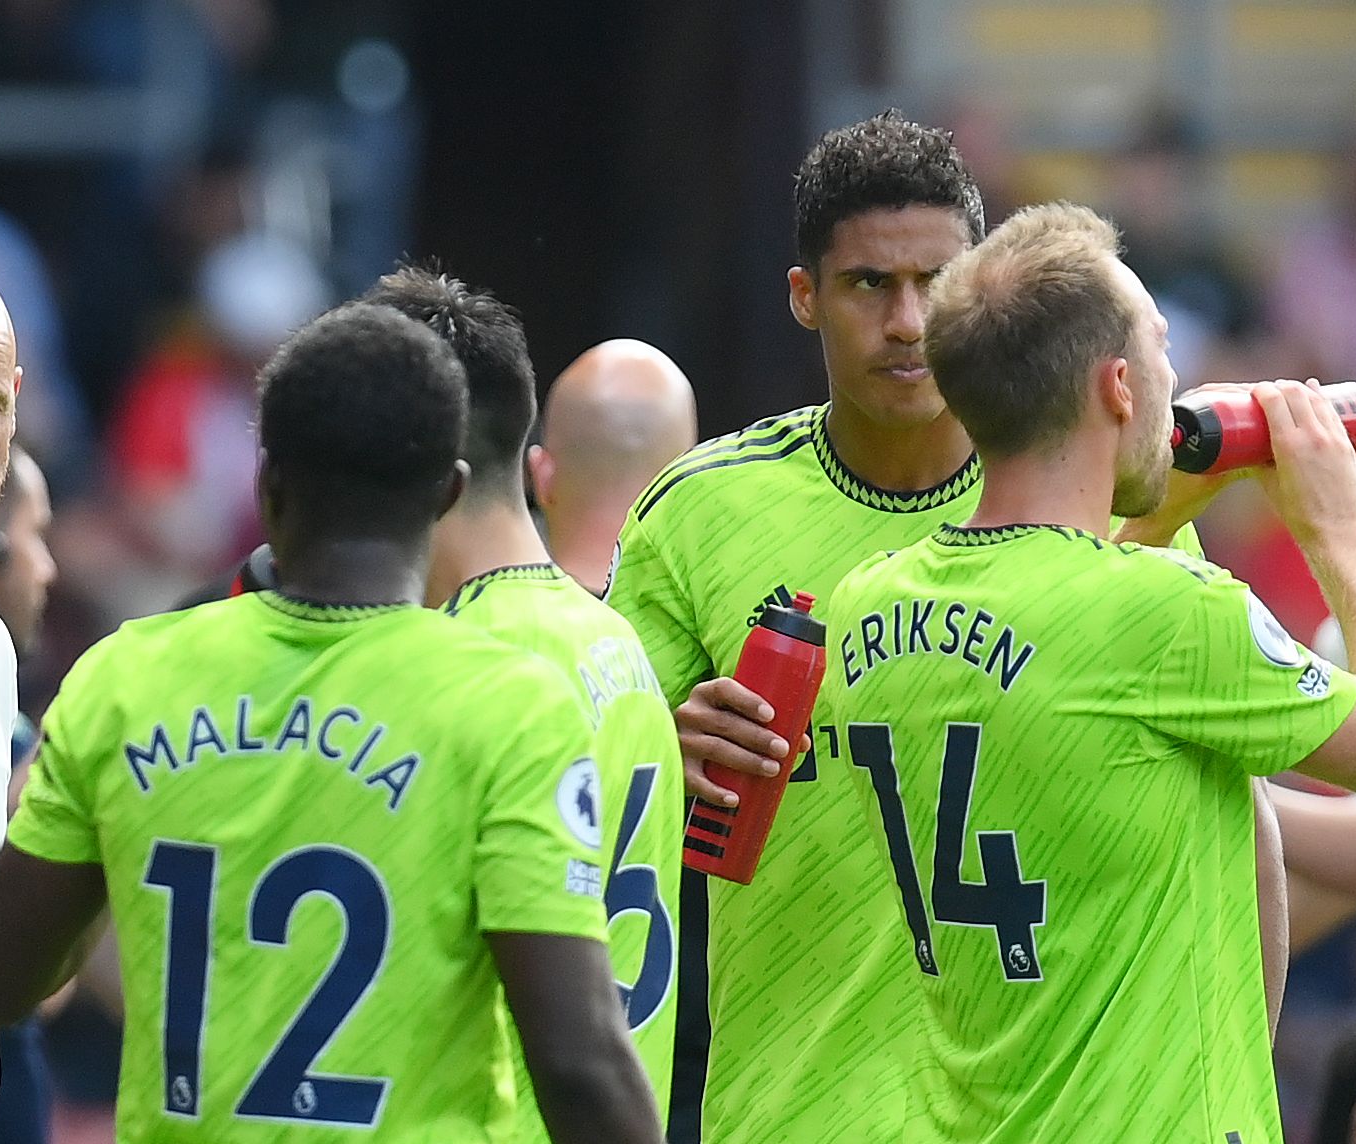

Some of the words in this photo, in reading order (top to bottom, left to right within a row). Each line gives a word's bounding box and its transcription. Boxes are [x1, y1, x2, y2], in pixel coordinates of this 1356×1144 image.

[123, 695, 423, 812] MALACIA
[840, 598, 1036, 693] ERIKSEN
[143, 837, 393, 1127] 12
[604, 763, 676, 1034] 6
[847, 721, 1047, 982] 14
